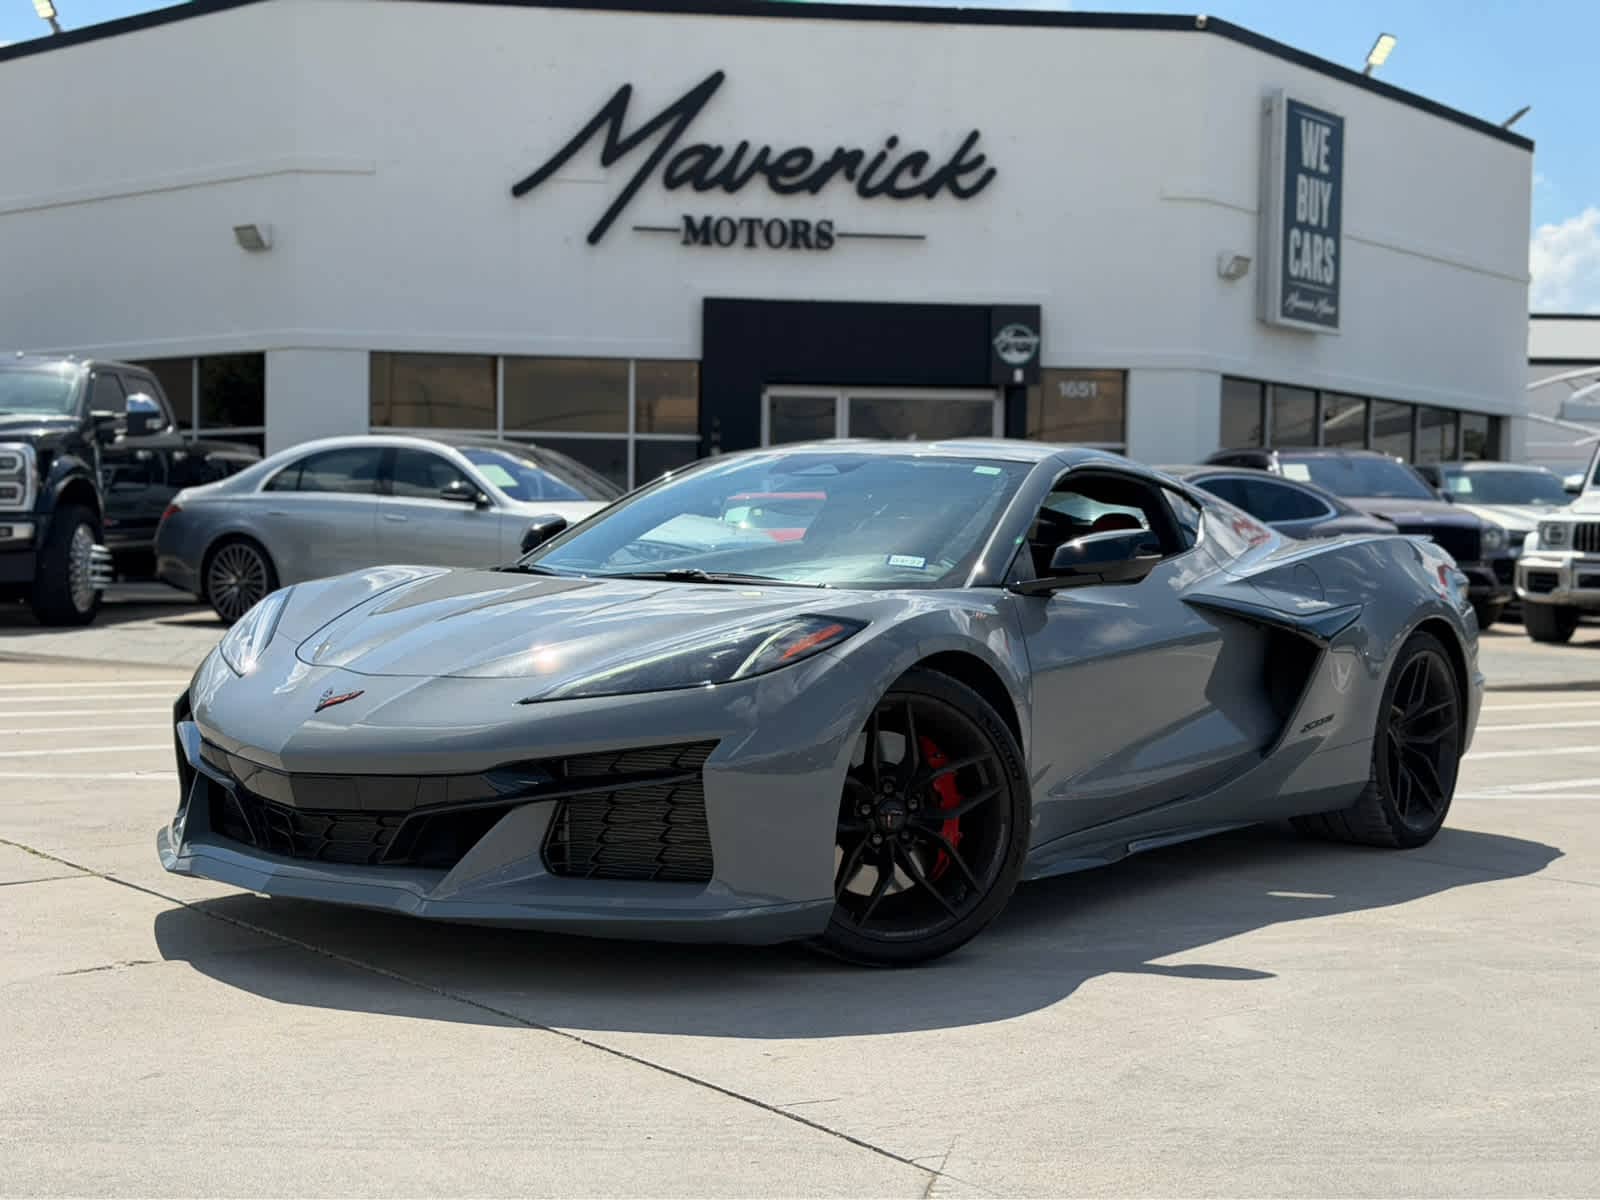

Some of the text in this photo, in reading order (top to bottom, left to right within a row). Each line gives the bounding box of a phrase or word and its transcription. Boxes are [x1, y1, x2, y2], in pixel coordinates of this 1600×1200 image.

[511, 69, 997, 246] Maverick
[1301, 118, 1331, 173] WE
[1297, 174, 1333, 228] BUY
[680, 215, 835, 250] MOTORS
[1289, 228, 1335, 285] CARS
